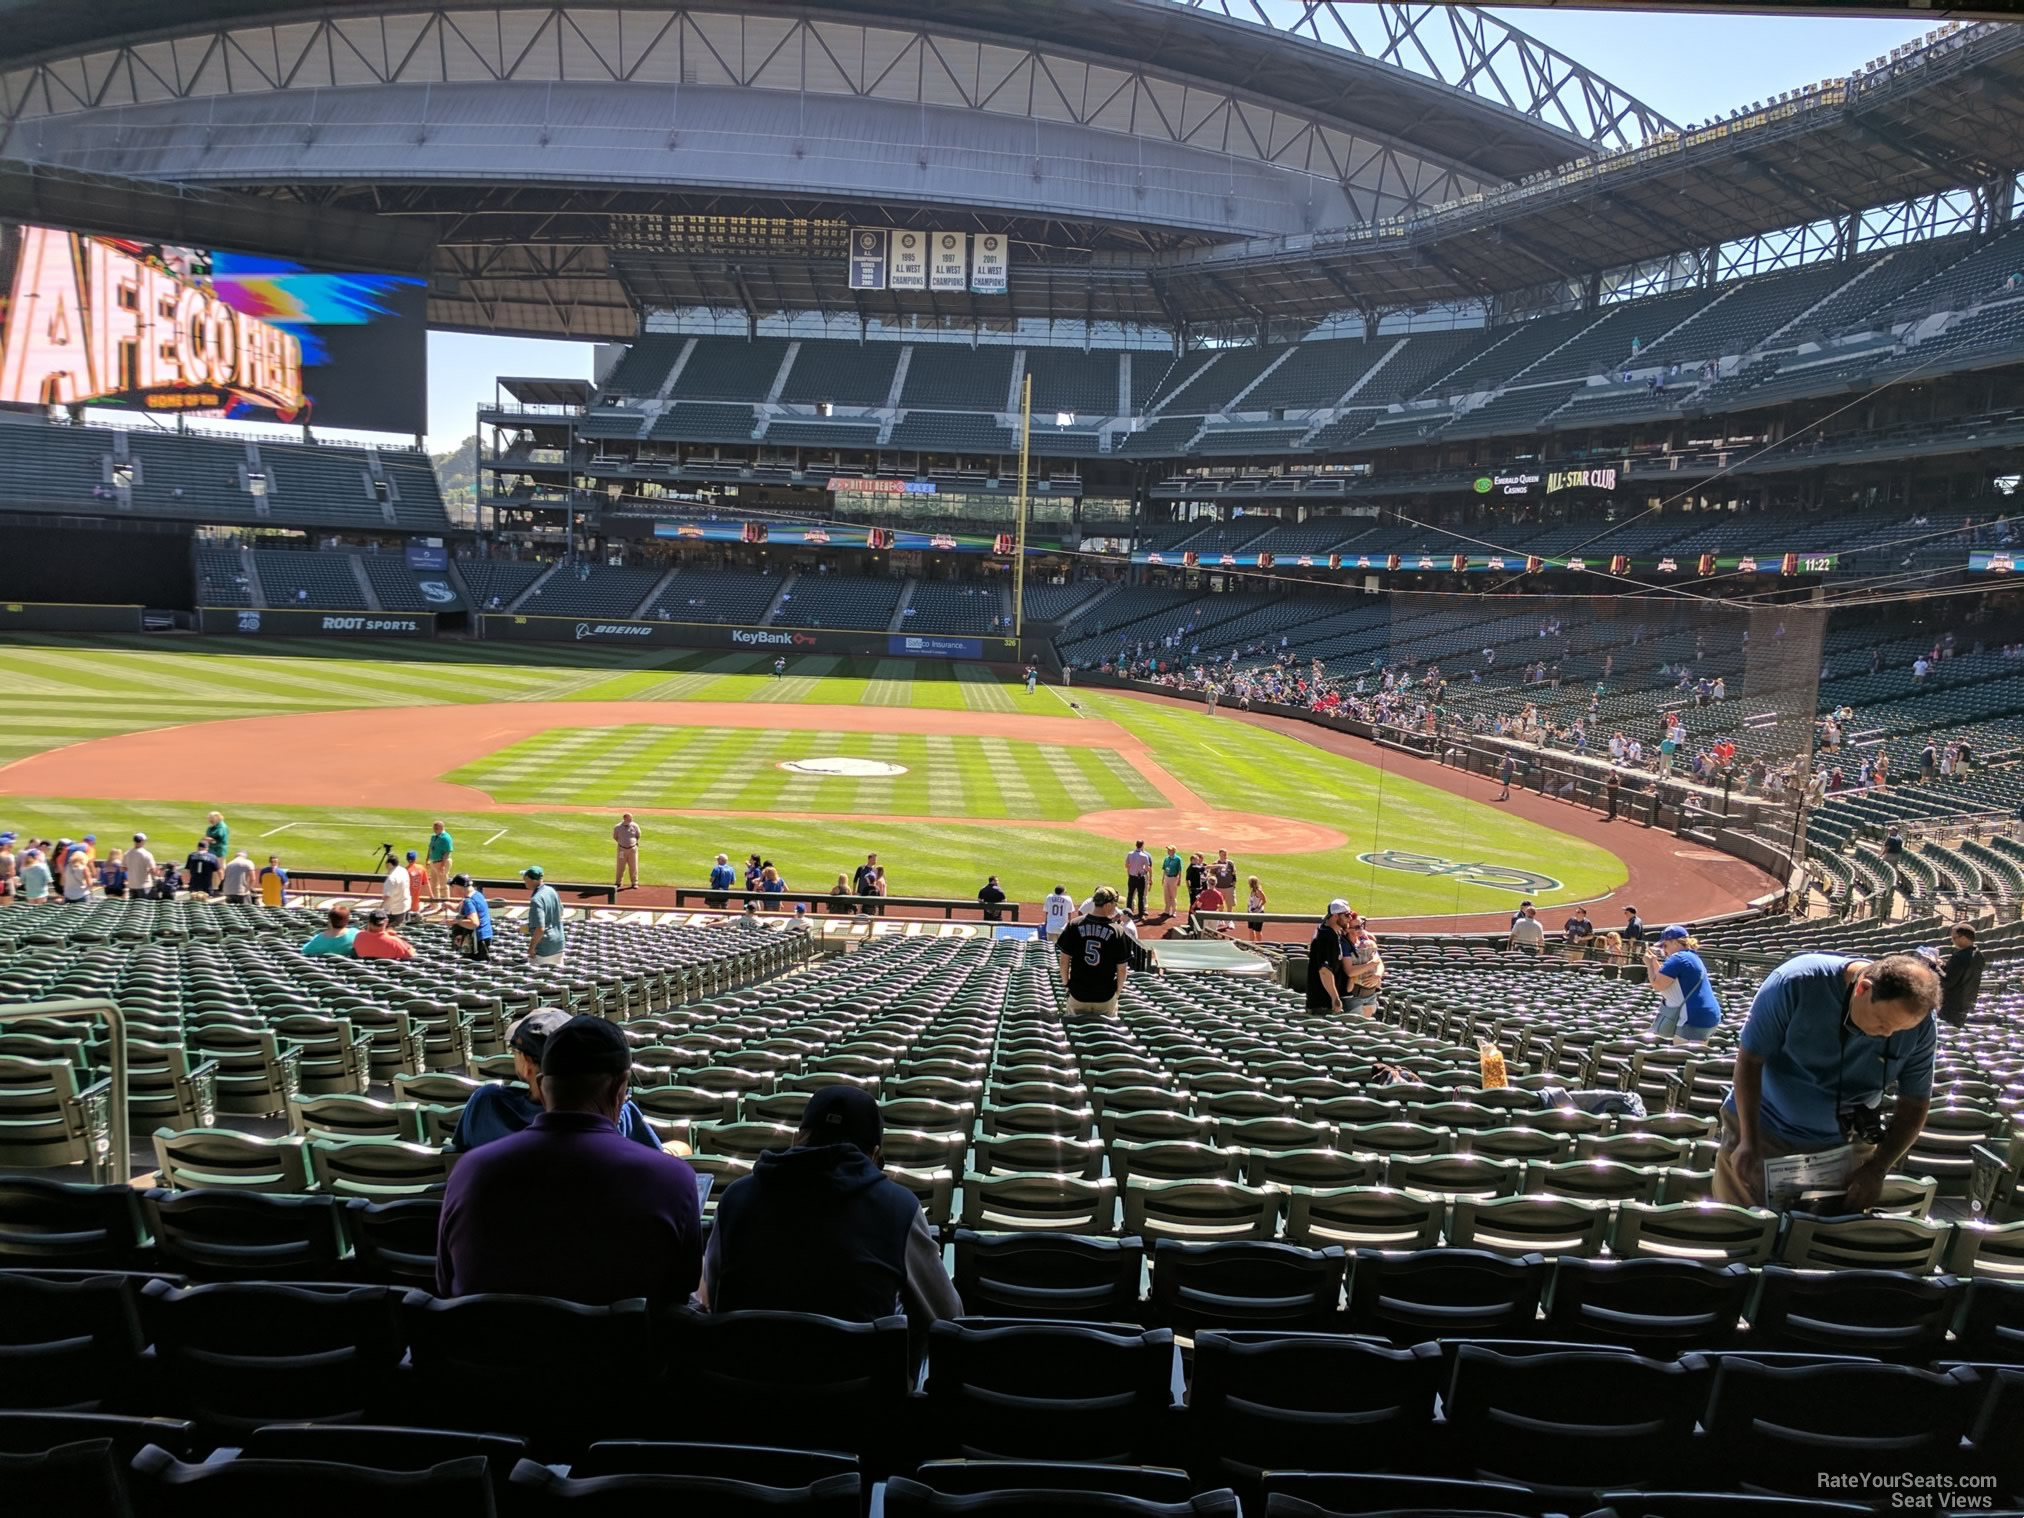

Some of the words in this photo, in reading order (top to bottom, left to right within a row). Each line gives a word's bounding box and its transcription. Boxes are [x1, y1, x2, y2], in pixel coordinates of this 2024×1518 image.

[902, 253, 915, 262] 1995
[942, 254, 955, 263] 1997
[983, 254, 997, 264] 2001
[906, 265, 921, 274] WEST
[946, 266, 961, 274] WEST
[987, 267, 1002, 275] WEST
[892, 276, 924, 286] CHAMPIONS
[932, 277, 964, 287] CHAMPIONS
[974, 277, 1005, 287] CHAMPIONS
[0, 225, 238, 403] AFECO
[1590, 469, 1616, 490] CLUB
[1805, 559, 1830, 571] 11:22
[322, 617, 365, 630] ROOT
[366, 620, 416, 631] SPORTS
[594, 625, 653, 636] BOEING
[732, 630, 792, 645] KeyBank
[932, 640, 963, 649] Insurance
[1052, 904, 1064, 917] 01
[1078, 924, 1114, 941] WRIGHT
[1084, 940, 1101, 967] 5
